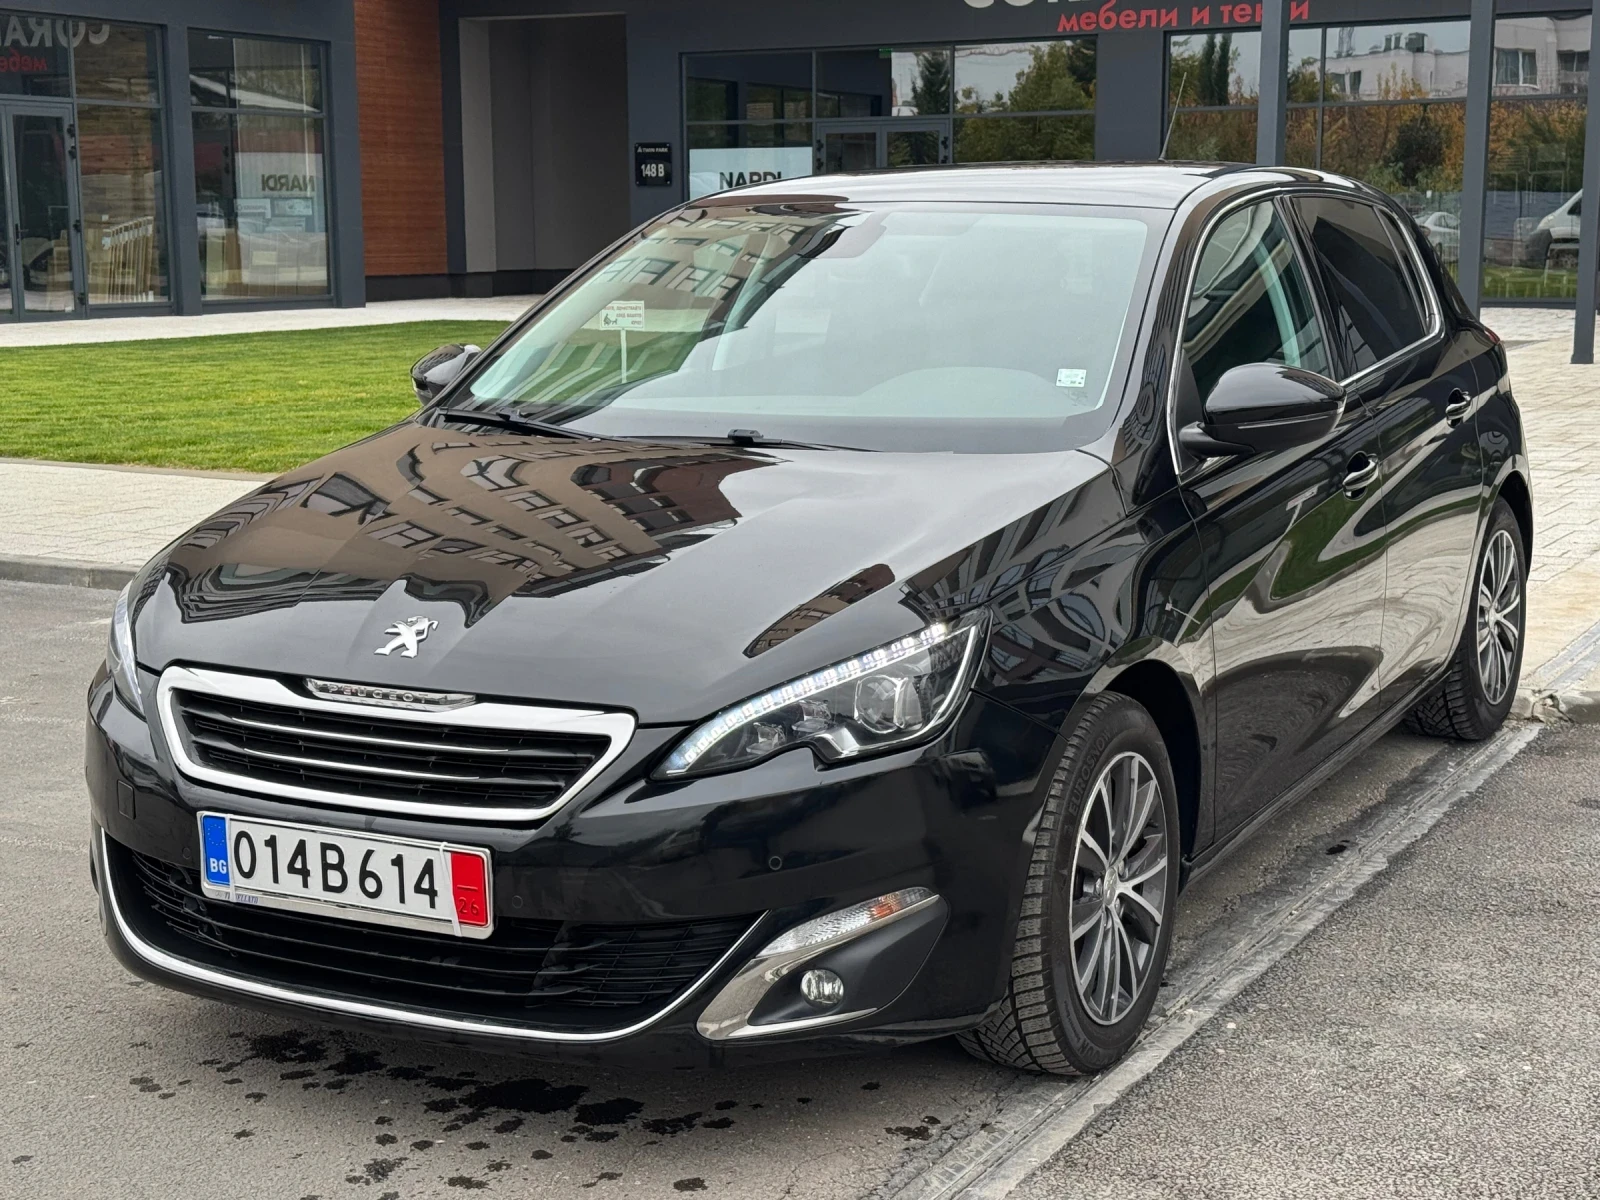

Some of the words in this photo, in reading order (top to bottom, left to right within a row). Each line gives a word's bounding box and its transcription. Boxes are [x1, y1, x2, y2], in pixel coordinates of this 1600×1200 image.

[1057, 0, 1178, 32] мебели
[1191, 6, 1210, 26] и
[1220, 0, 1309, 24] теи
[641, 163, 657, 178] 148
[328, 683, 429, 704] PEUGEOT
[209, 857, 227, 875] BG
[233, 829, 438, 909] 014B614
[459, 897, 480, 916] 26
